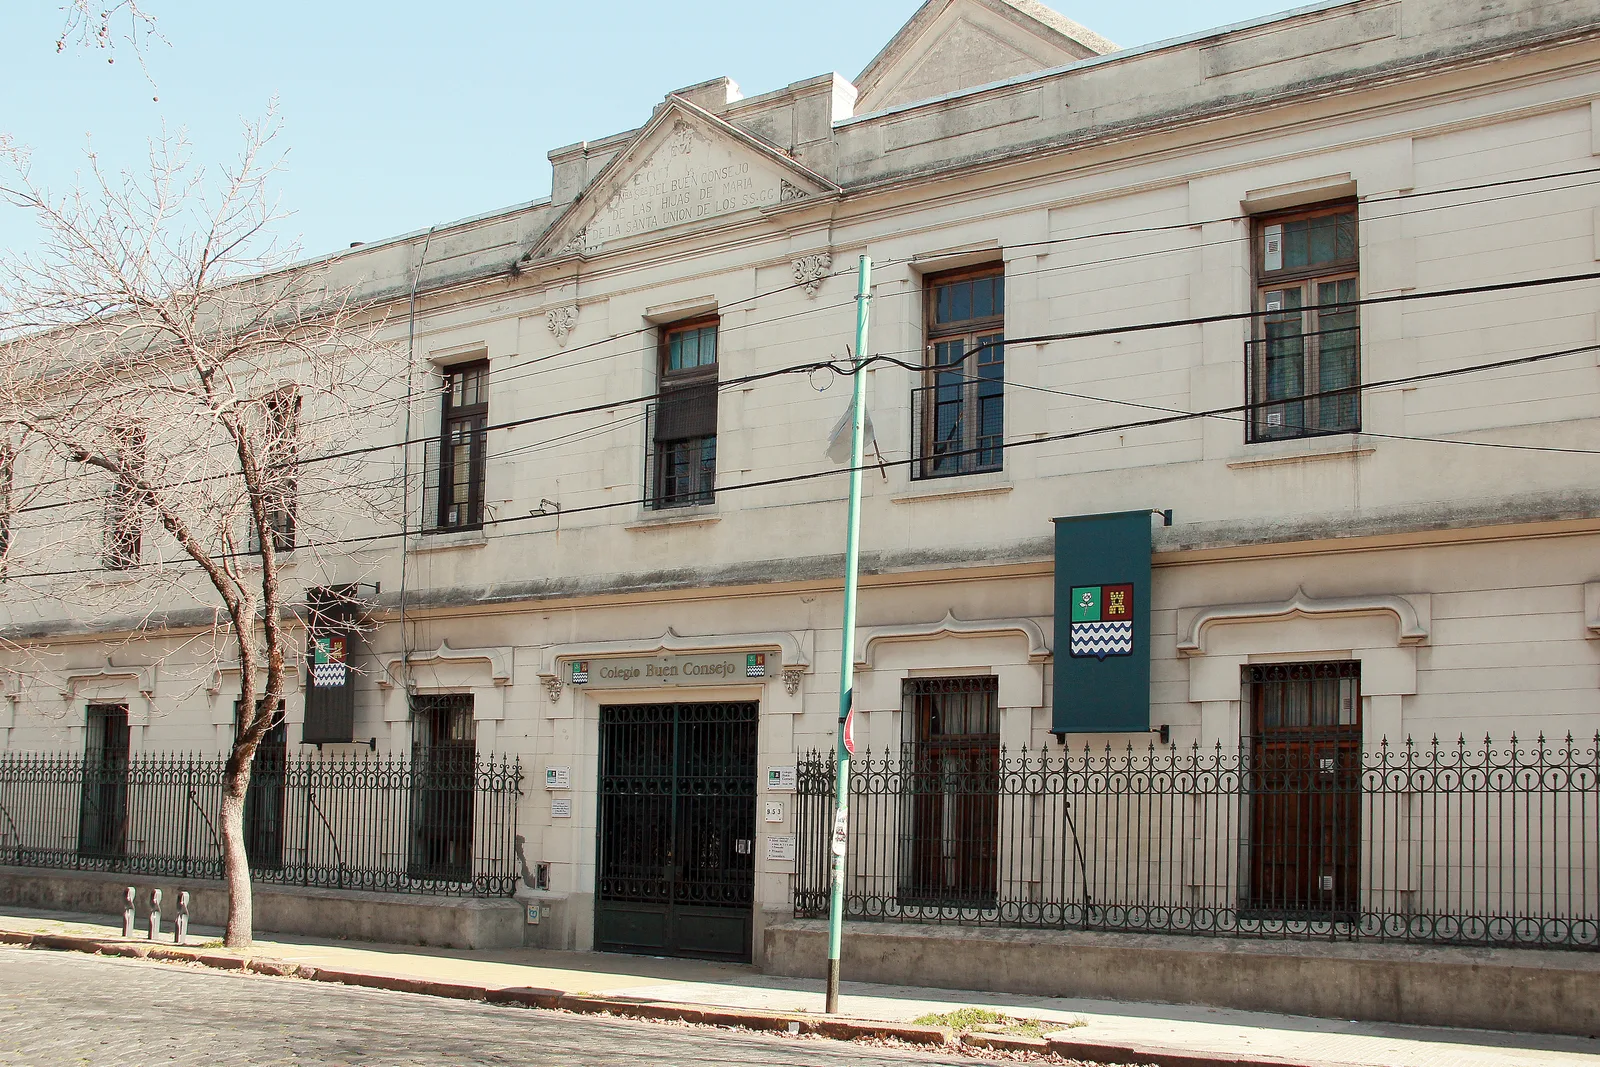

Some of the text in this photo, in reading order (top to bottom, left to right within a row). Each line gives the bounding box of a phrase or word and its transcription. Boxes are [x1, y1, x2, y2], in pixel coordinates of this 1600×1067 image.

[612, 177, 753, 221] DE LAS HIJAS DE MARIA
[649, 182, 668, 197] DEL
[671, 175, 698, 192] BUEN
[700, 162, 749, 184] CONSEJO
[592, 227, 605, 241] DE
[608, 224, 621, 237] LA
[626, 215, 658, 233] SANTA
[662, 206, 693, 224] UNION
[697, 202, 711, 217] DE
[716, 197, 736, 213] LOS
[600, 660, 736, 681] Colegio Buen Consejo
